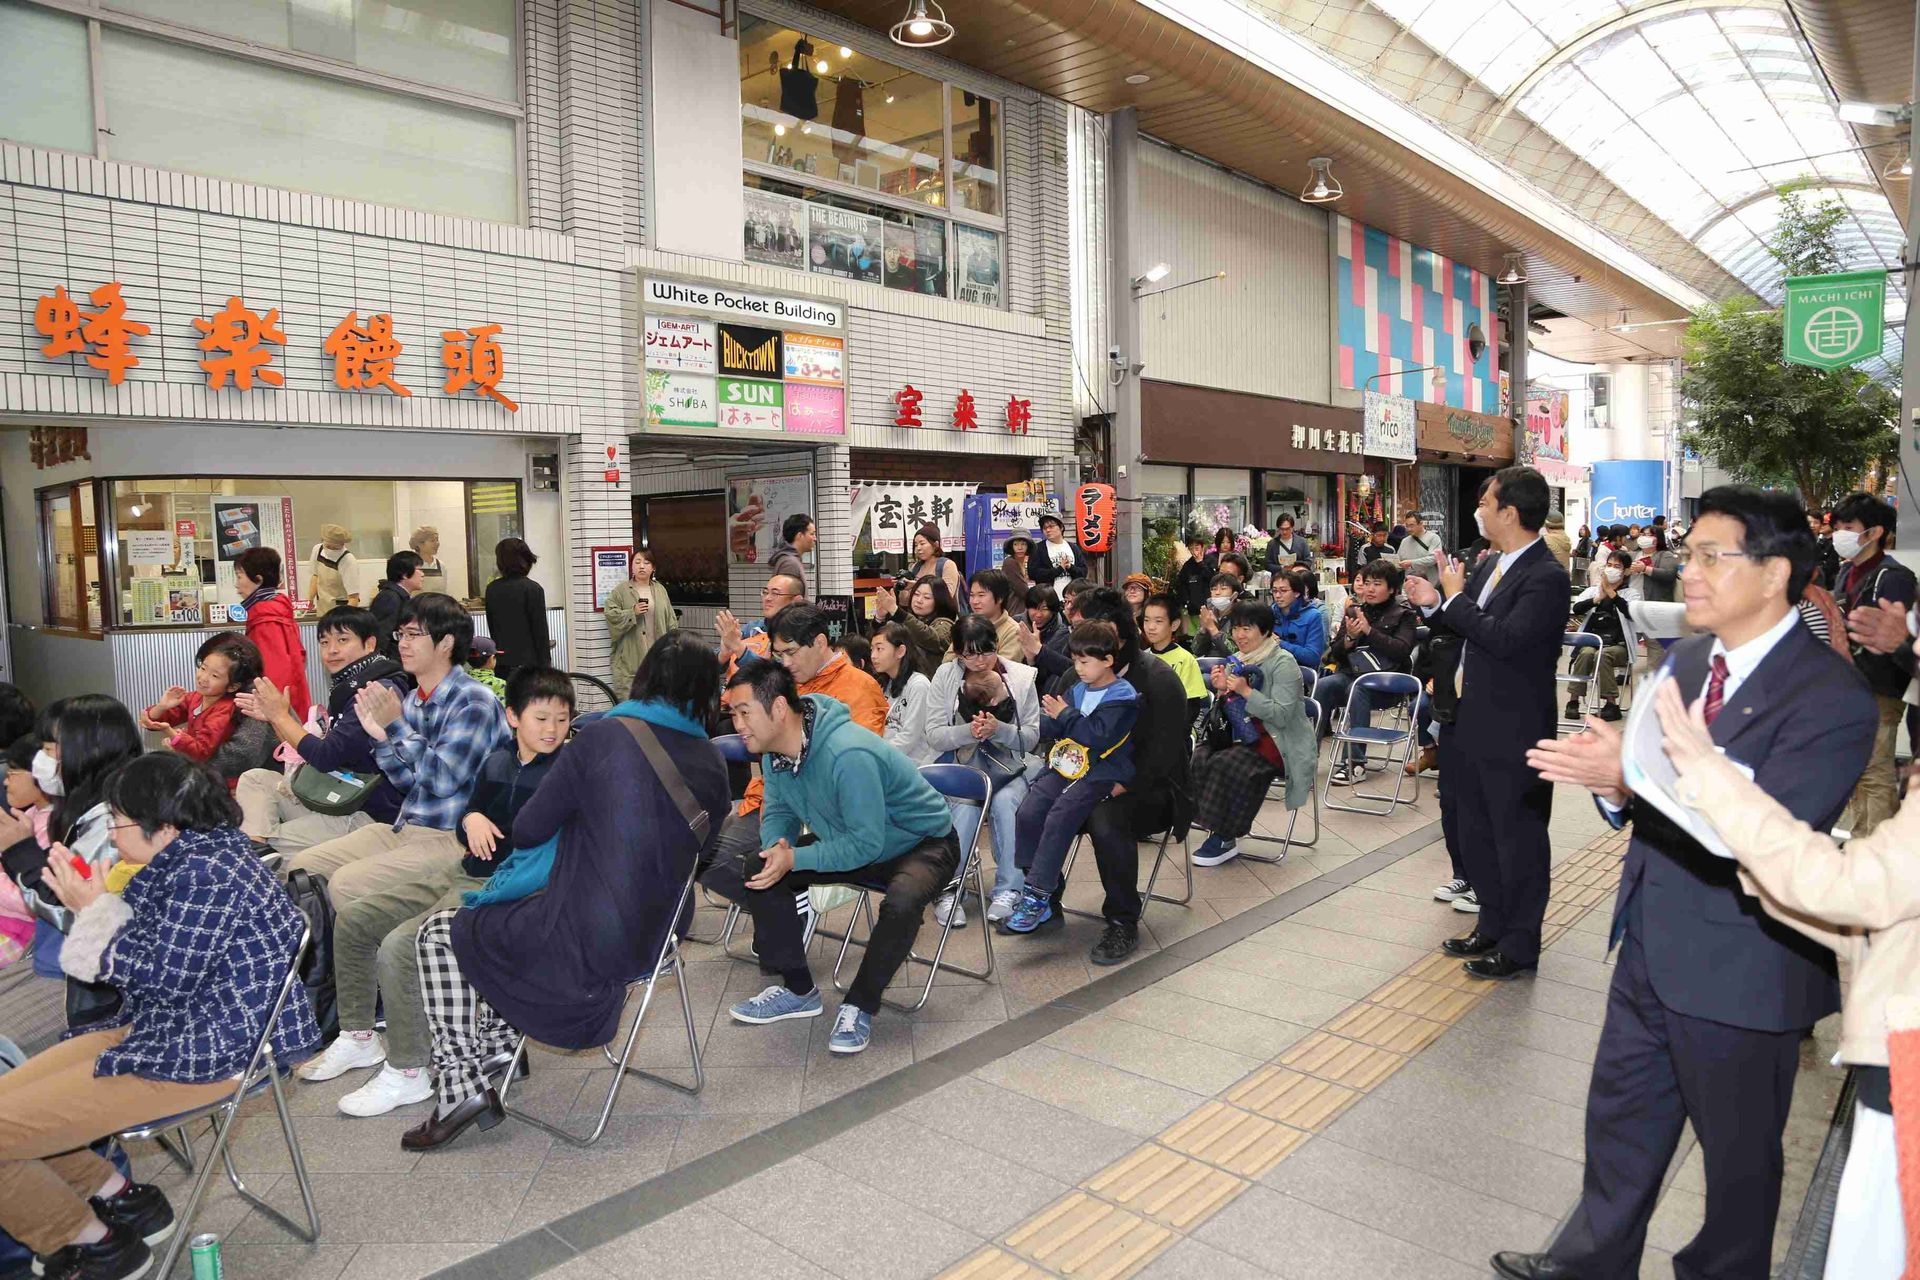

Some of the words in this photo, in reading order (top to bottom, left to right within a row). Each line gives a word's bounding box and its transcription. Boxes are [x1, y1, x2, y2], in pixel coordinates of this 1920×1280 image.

[810, 207, 827, 224] THE
[828, 208, 868, 233] BEATNUTS
[652, 283, 709, 305] White
[714, 292, 769, 314] Pocket
[774, 301, 836, 326] Building
[1797, 292, 1840, 304] MACHI
[1845, 290, 1873, 300] ICHI
[34, 282, 519, 413] 蜂楽饅頭
[646, 331, 713, 351] ジェムアート
[673, 386, 699, 395] 株式会社
[727, 382, 774, 404] SUN
[669, 396, 708, 409] SHIBA
[893, 384, 1032, 435] 宝来軒
[720, 406, 781, 428] はぁーと
[1379, 420, 1399, 438] nico
[873, 494, 954, 531] 宝来軒
[1081, 487, 1103, 547] ラーメン
